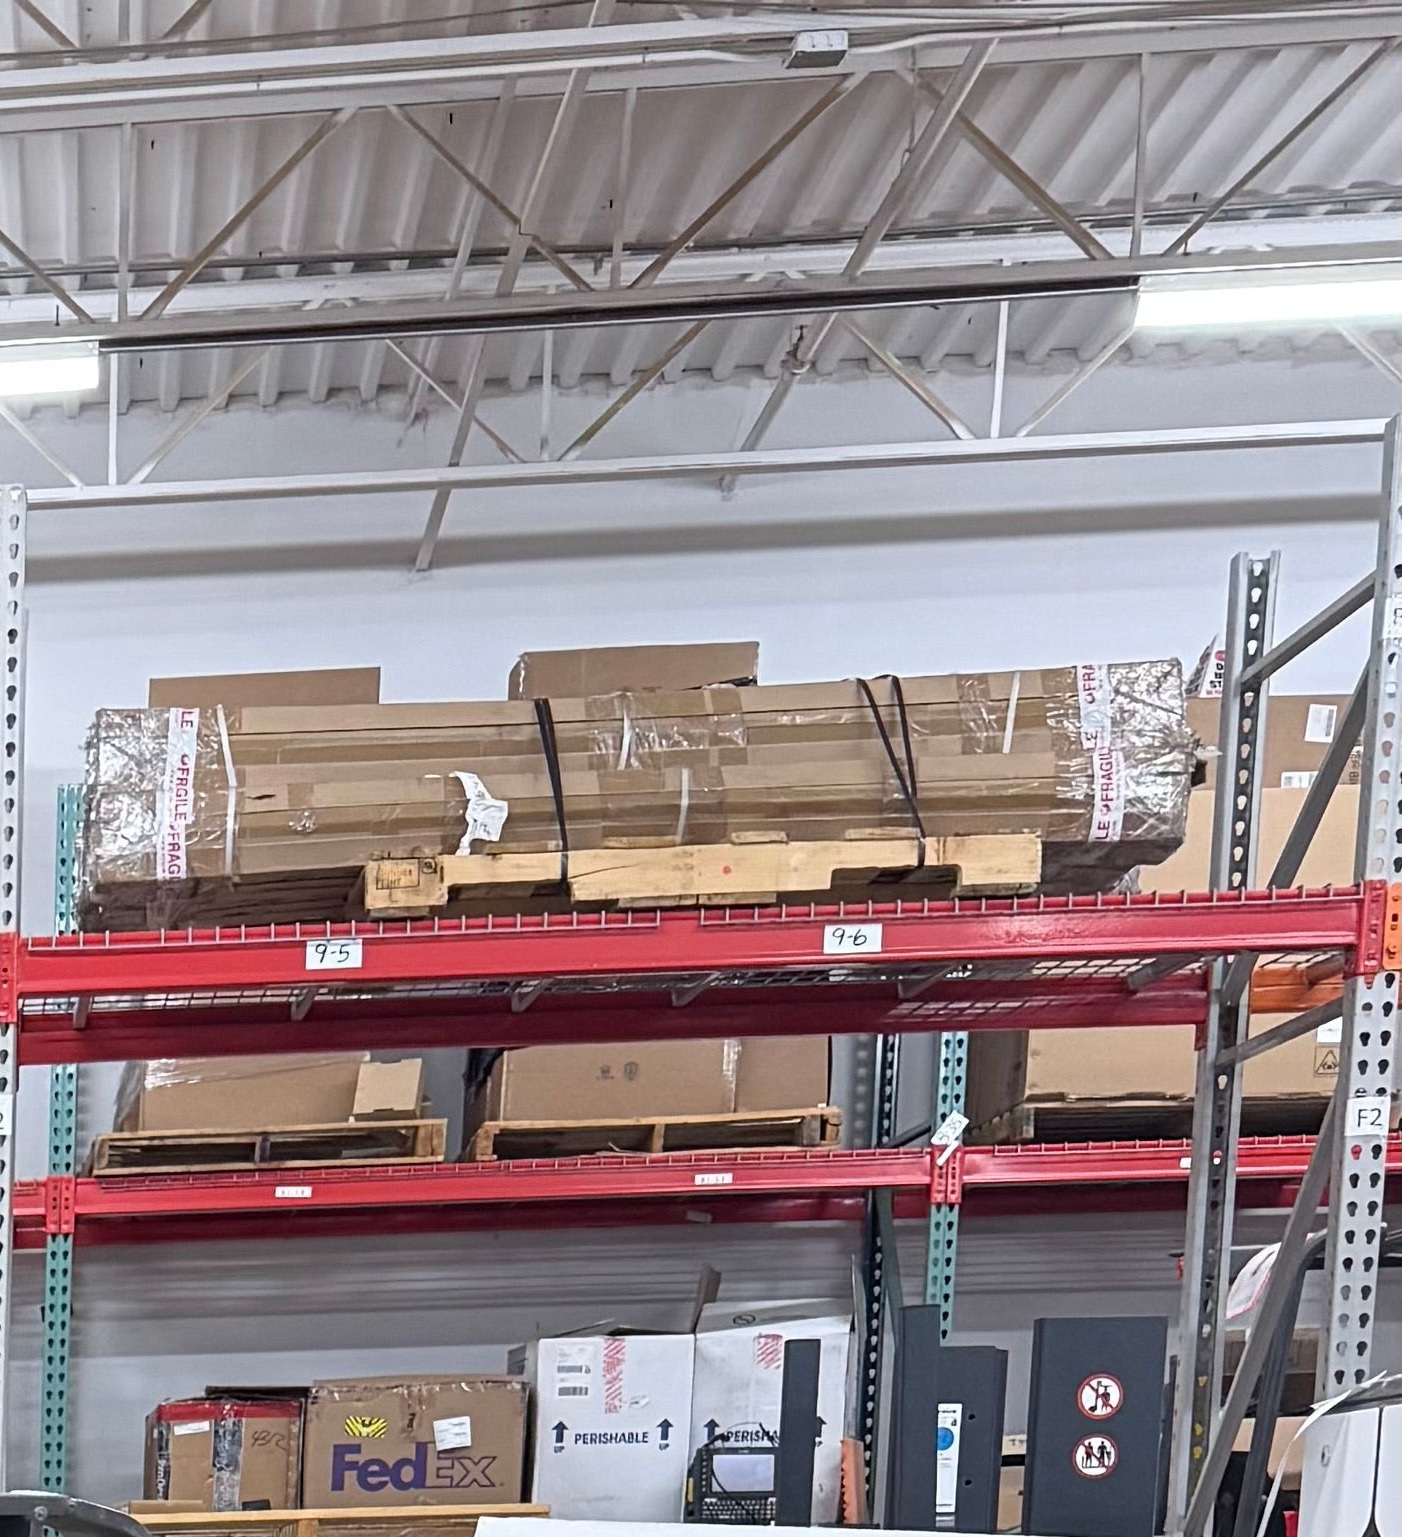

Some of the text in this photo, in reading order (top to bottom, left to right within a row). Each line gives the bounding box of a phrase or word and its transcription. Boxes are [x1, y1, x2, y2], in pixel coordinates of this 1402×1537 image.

[832, 927, 867, 946] 9-6
[315, 944, 349, 963] 9-5
[1357, 1108, 1383, 1127] F2
[574, 1432, 649, 1445] PERISHABLE
[331, 1441, 498, 1492] FedEx
